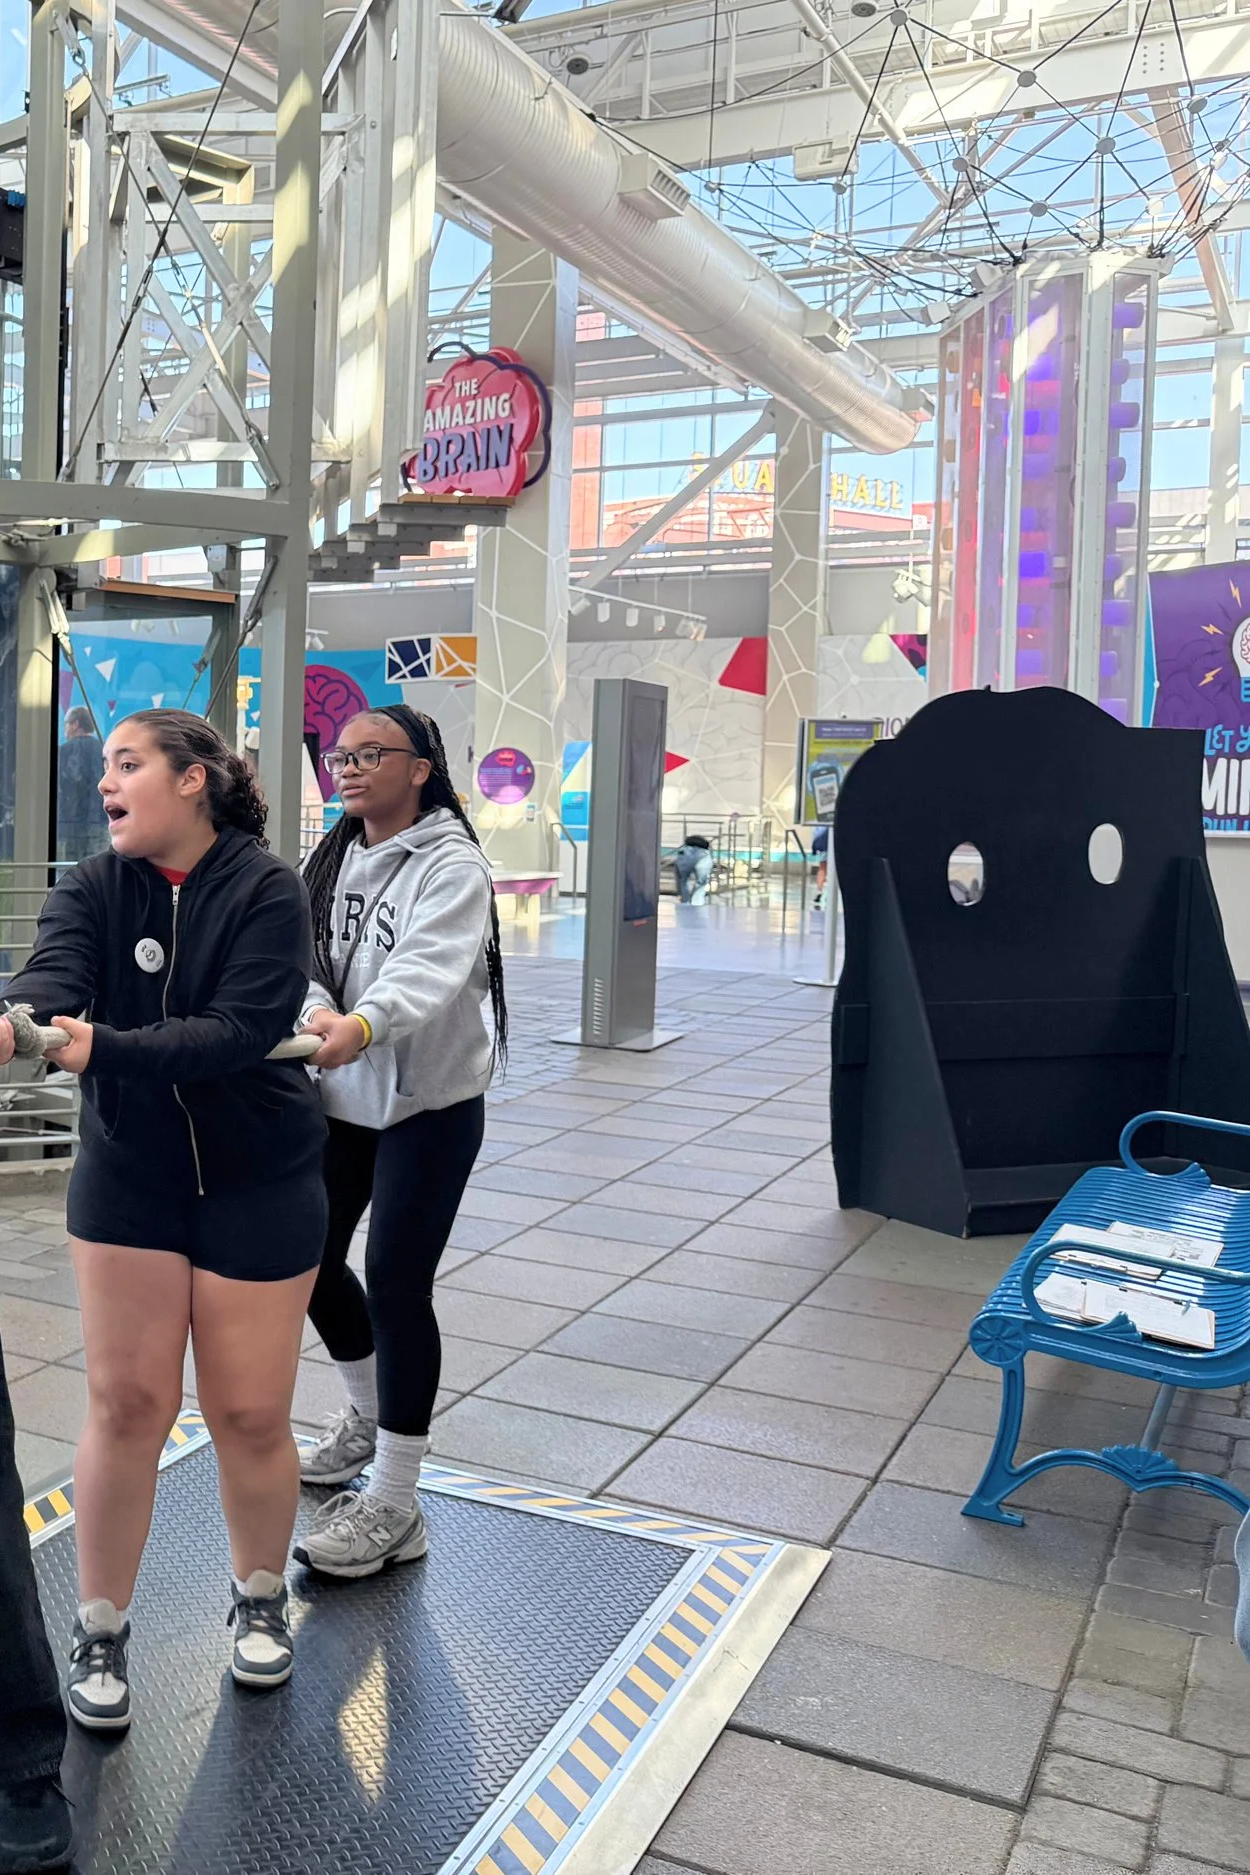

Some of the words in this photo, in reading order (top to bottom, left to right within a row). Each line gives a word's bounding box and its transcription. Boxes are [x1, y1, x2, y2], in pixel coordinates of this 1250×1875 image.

[454, 378, 478, 397] THE
[424, 392, 510, 432] AMAZING
[417, 423, 514, 483] BRAIN
[831, 472, 903, 509] HALL
[1204, 724, 1234, 756] LET
